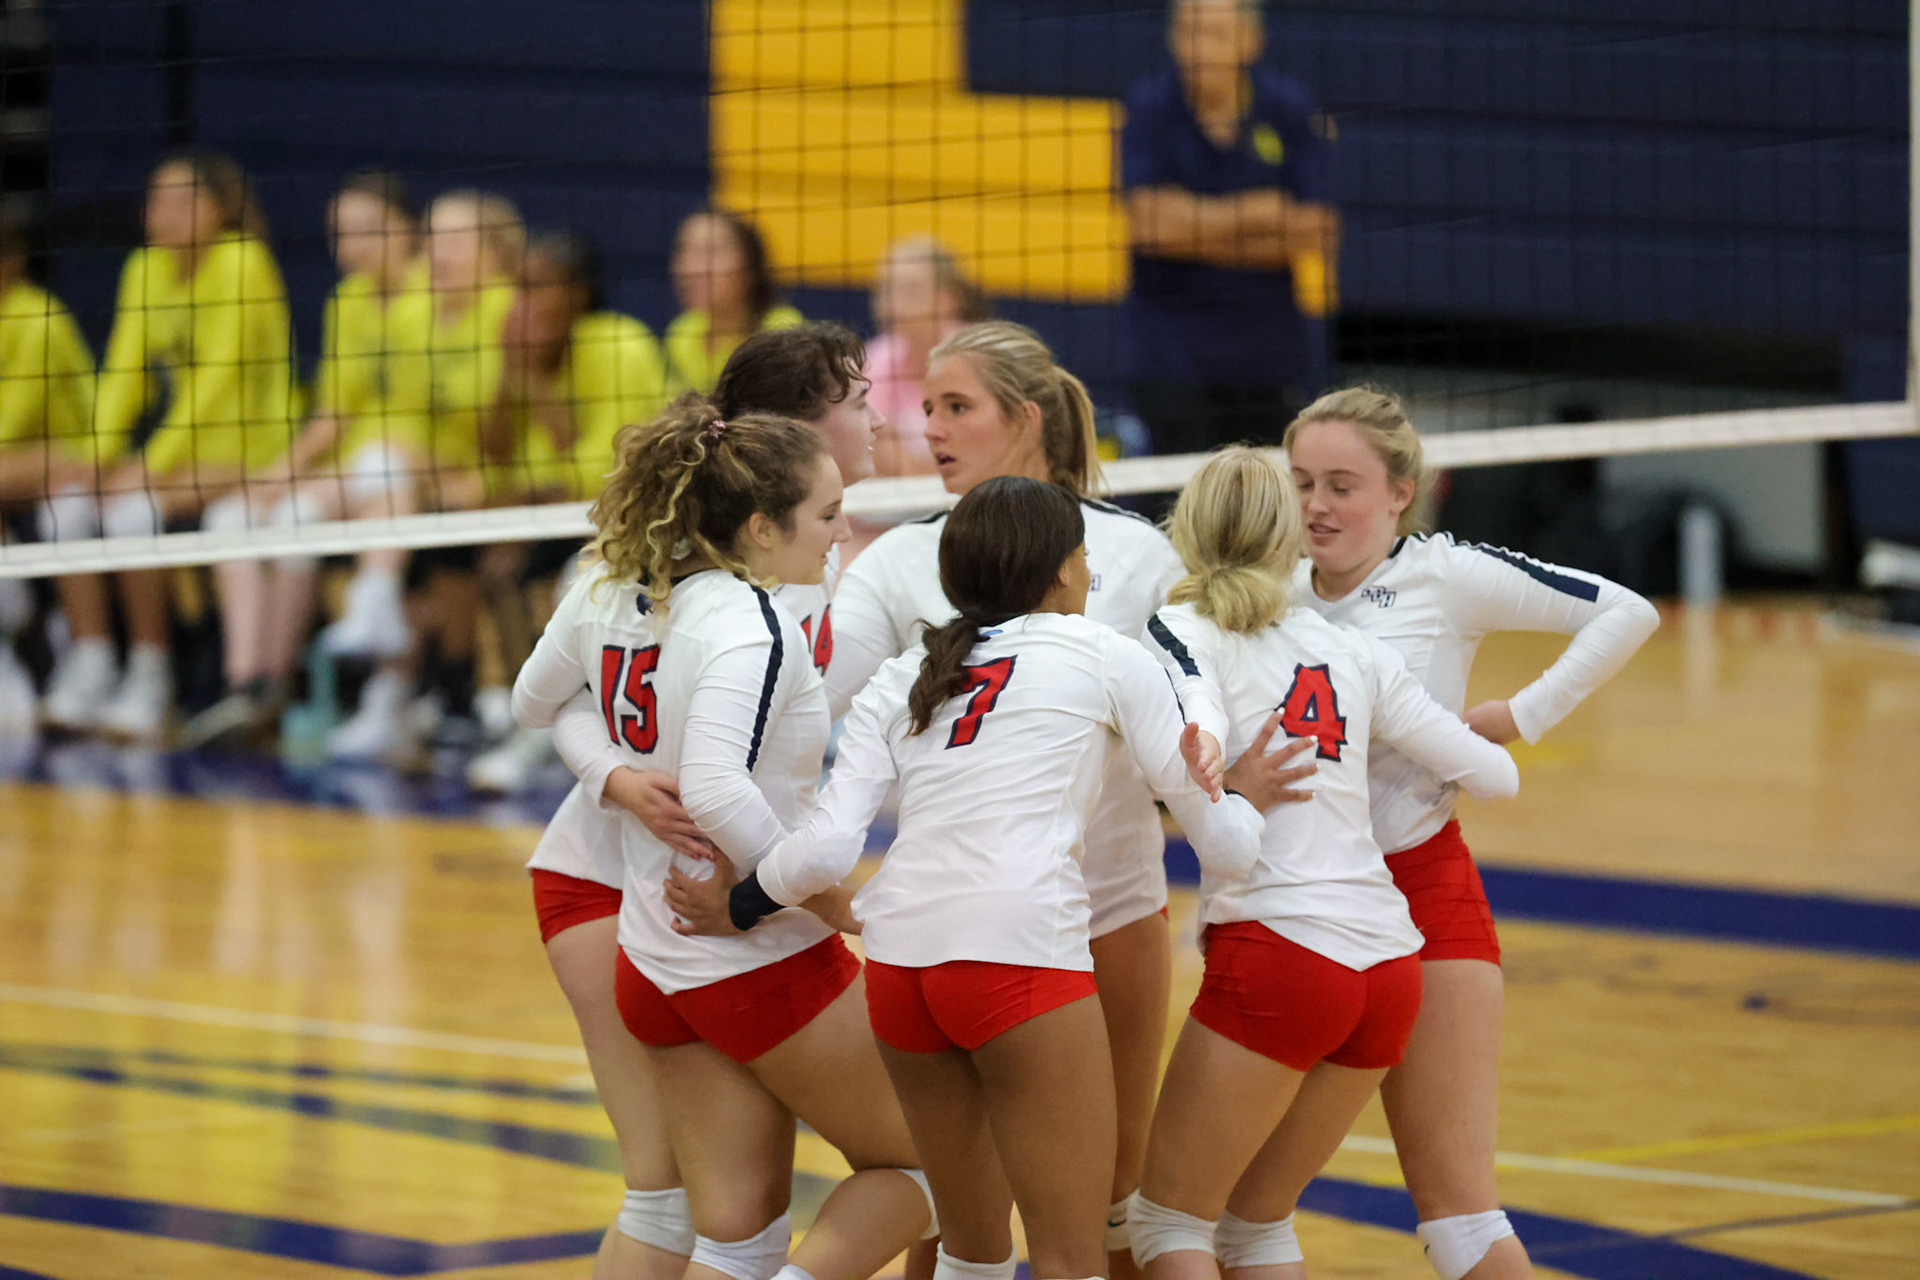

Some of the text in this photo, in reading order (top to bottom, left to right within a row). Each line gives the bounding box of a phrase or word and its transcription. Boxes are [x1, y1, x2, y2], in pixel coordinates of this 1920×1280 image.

[601, 644, 661, 755] 15
[944, 654, 1018, 750] 7
[1274, 662, 1348, 762] 4
